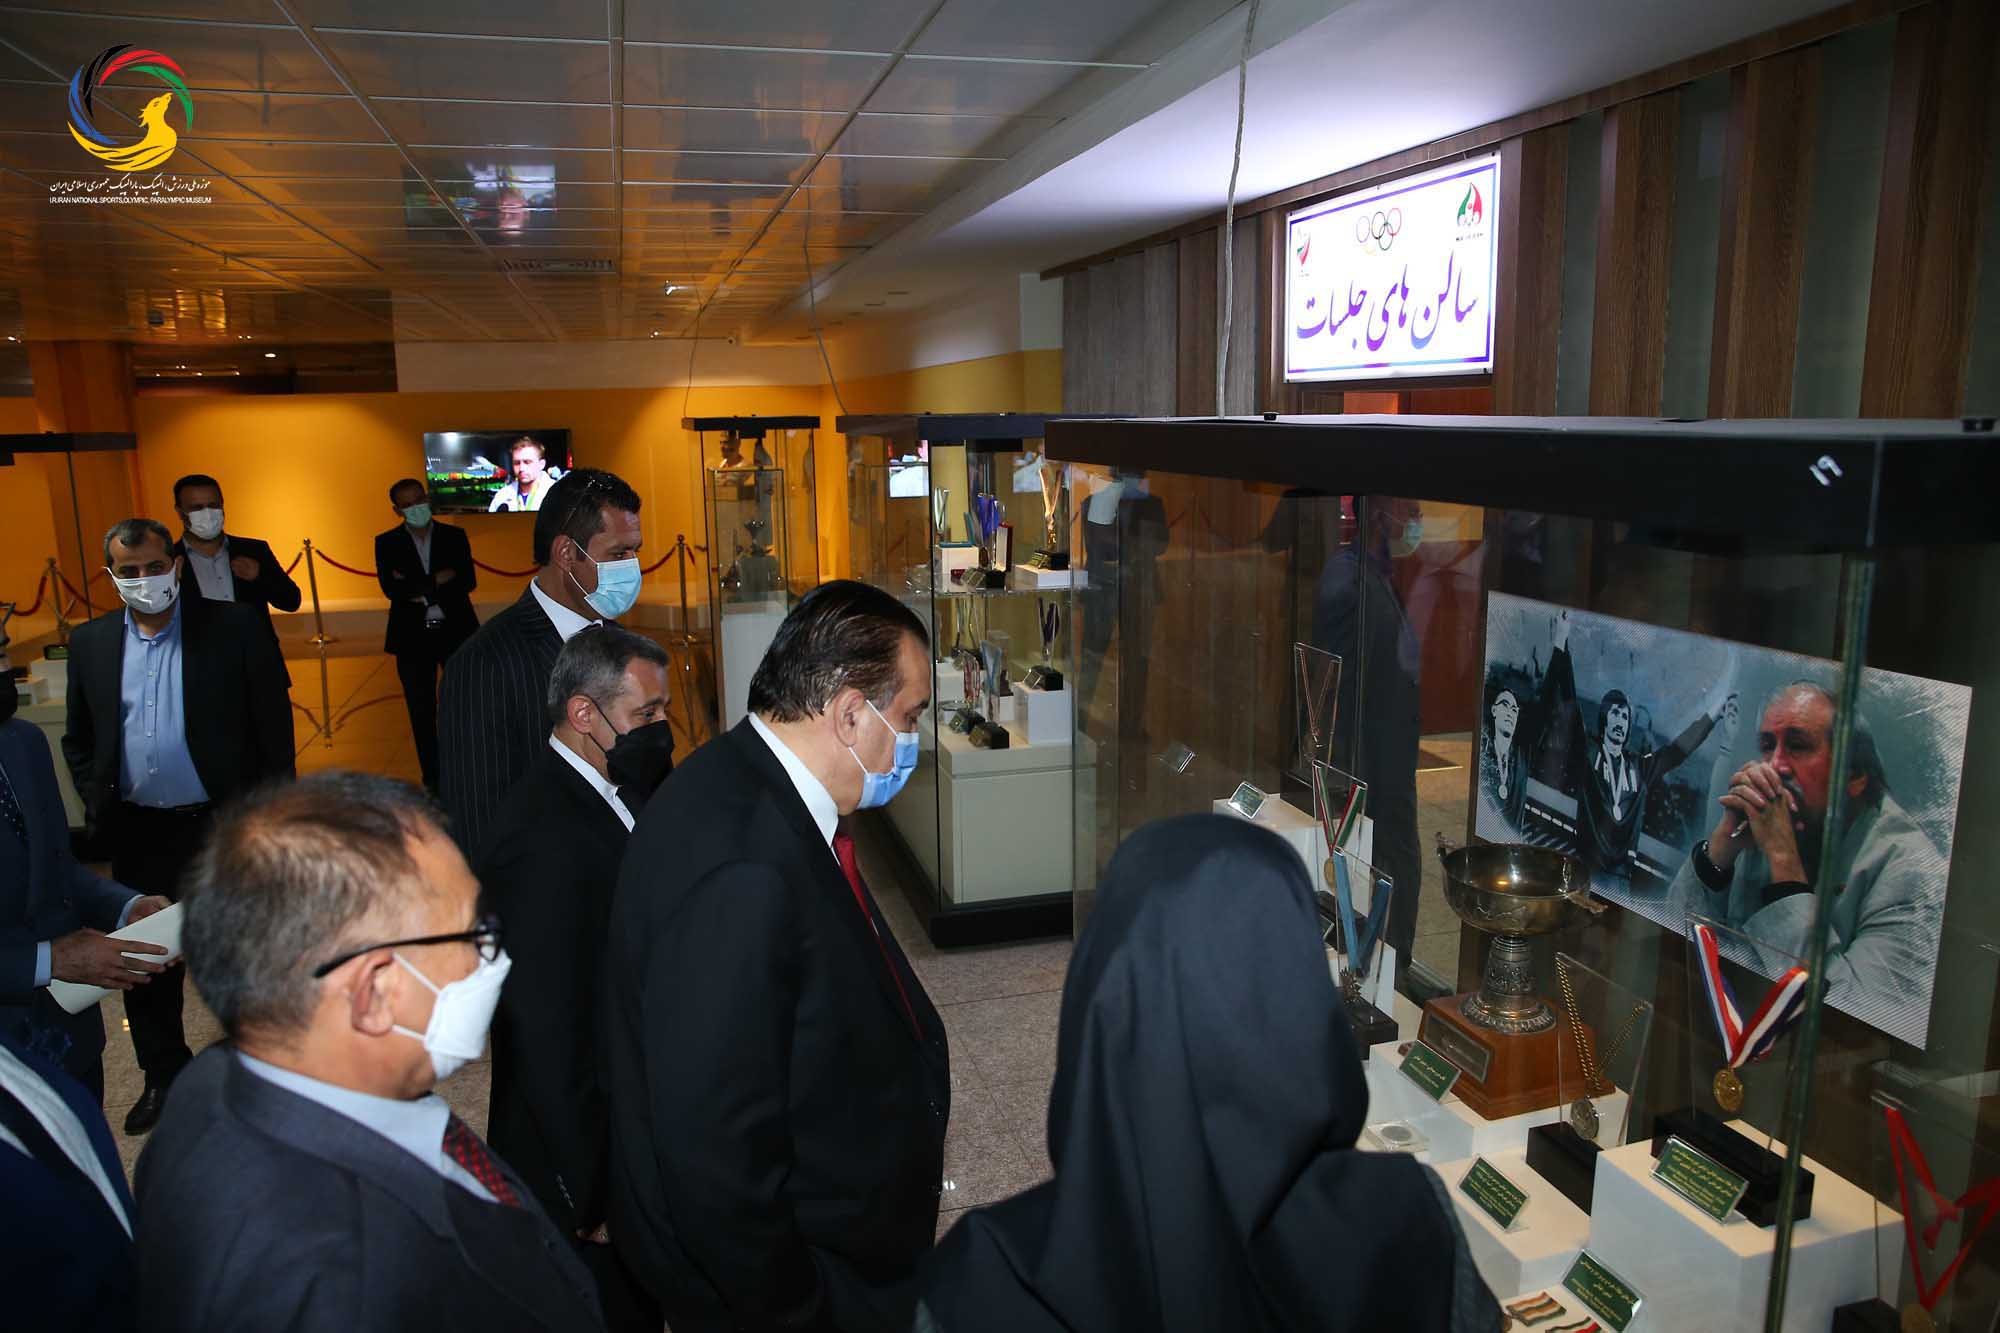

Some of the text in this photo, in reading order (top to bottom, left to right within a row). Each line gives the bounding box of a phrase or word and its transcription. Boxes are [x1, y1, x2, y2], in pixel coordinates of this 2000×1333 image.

[1296, 249, 1478, 352] سالن های جلسات
